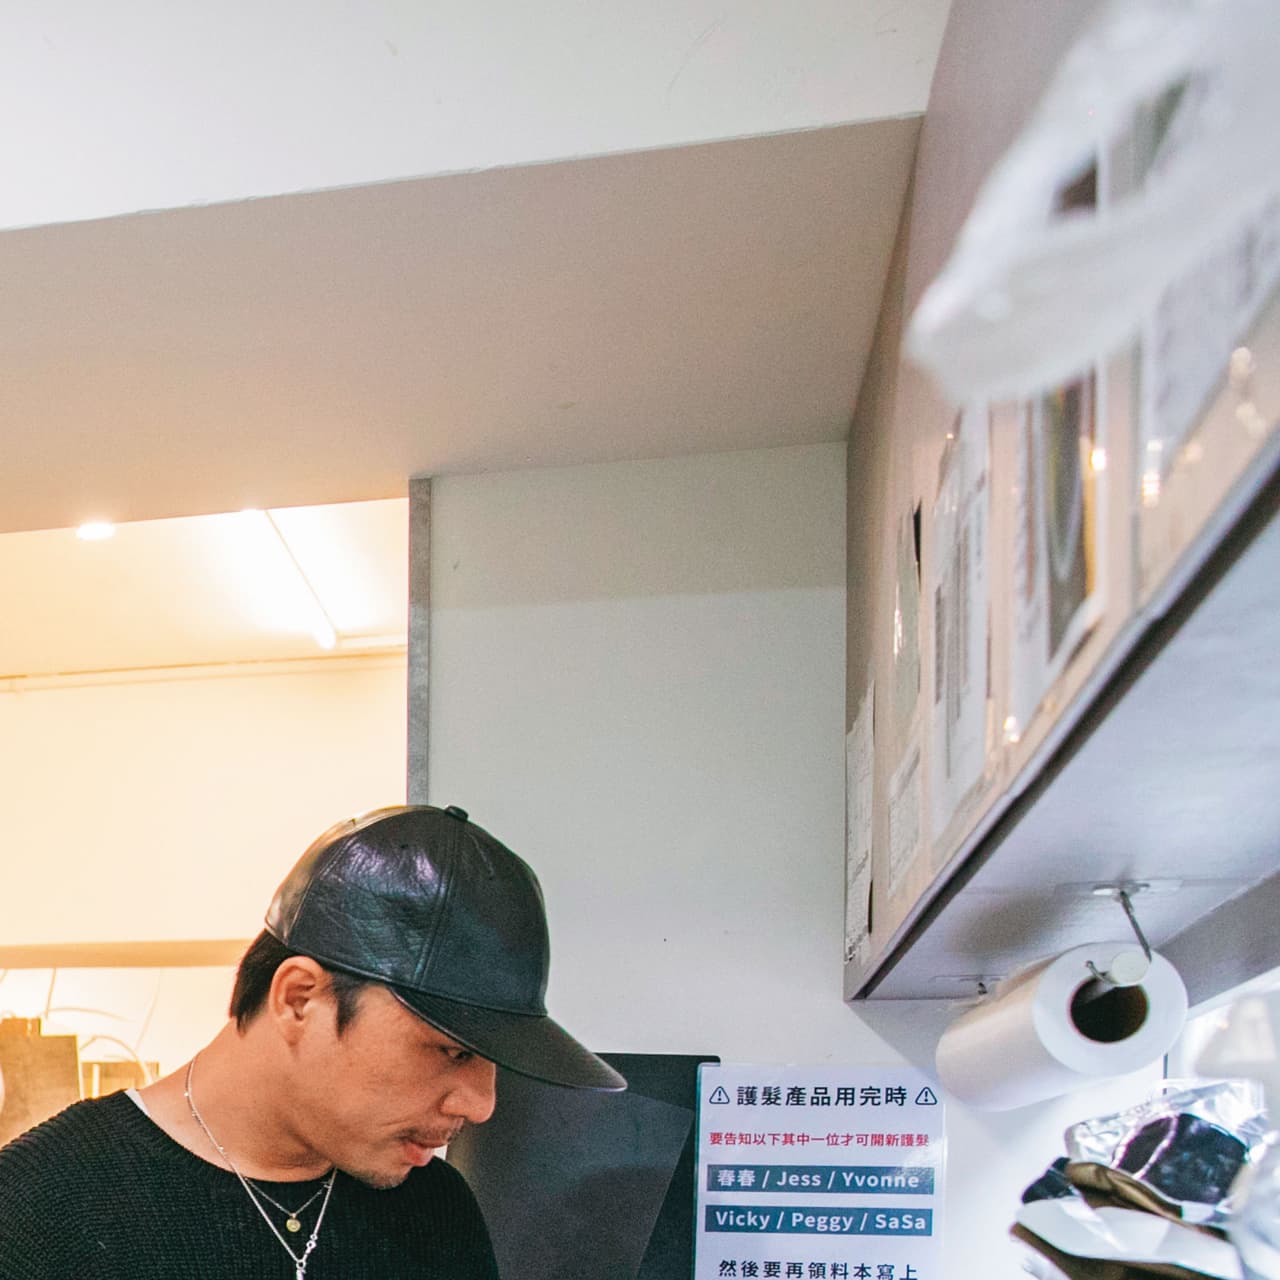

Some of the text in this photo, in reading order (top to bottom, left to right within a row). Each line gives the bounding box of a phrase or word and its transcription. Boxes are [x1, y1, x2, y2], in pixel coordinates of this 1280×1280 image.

[736, 1085, 908, 1107] 護髮產品用完時
[709, 1132, 930, 1147] 要告知以下其中一位才可開新護髮
[717, 1169, 755, 1187] 春春
[776, 1171, 822, 1187] Jess
[842, 1171, 920, 1188] Yvonne
[715, 1210, 771, 1230] Vicky
[791, 1212, 854, 1232] Peggy
[874, 1213, 926, 1230] SaSa
[718, 1259, 918, 1280] 然後要再領料本寫上
